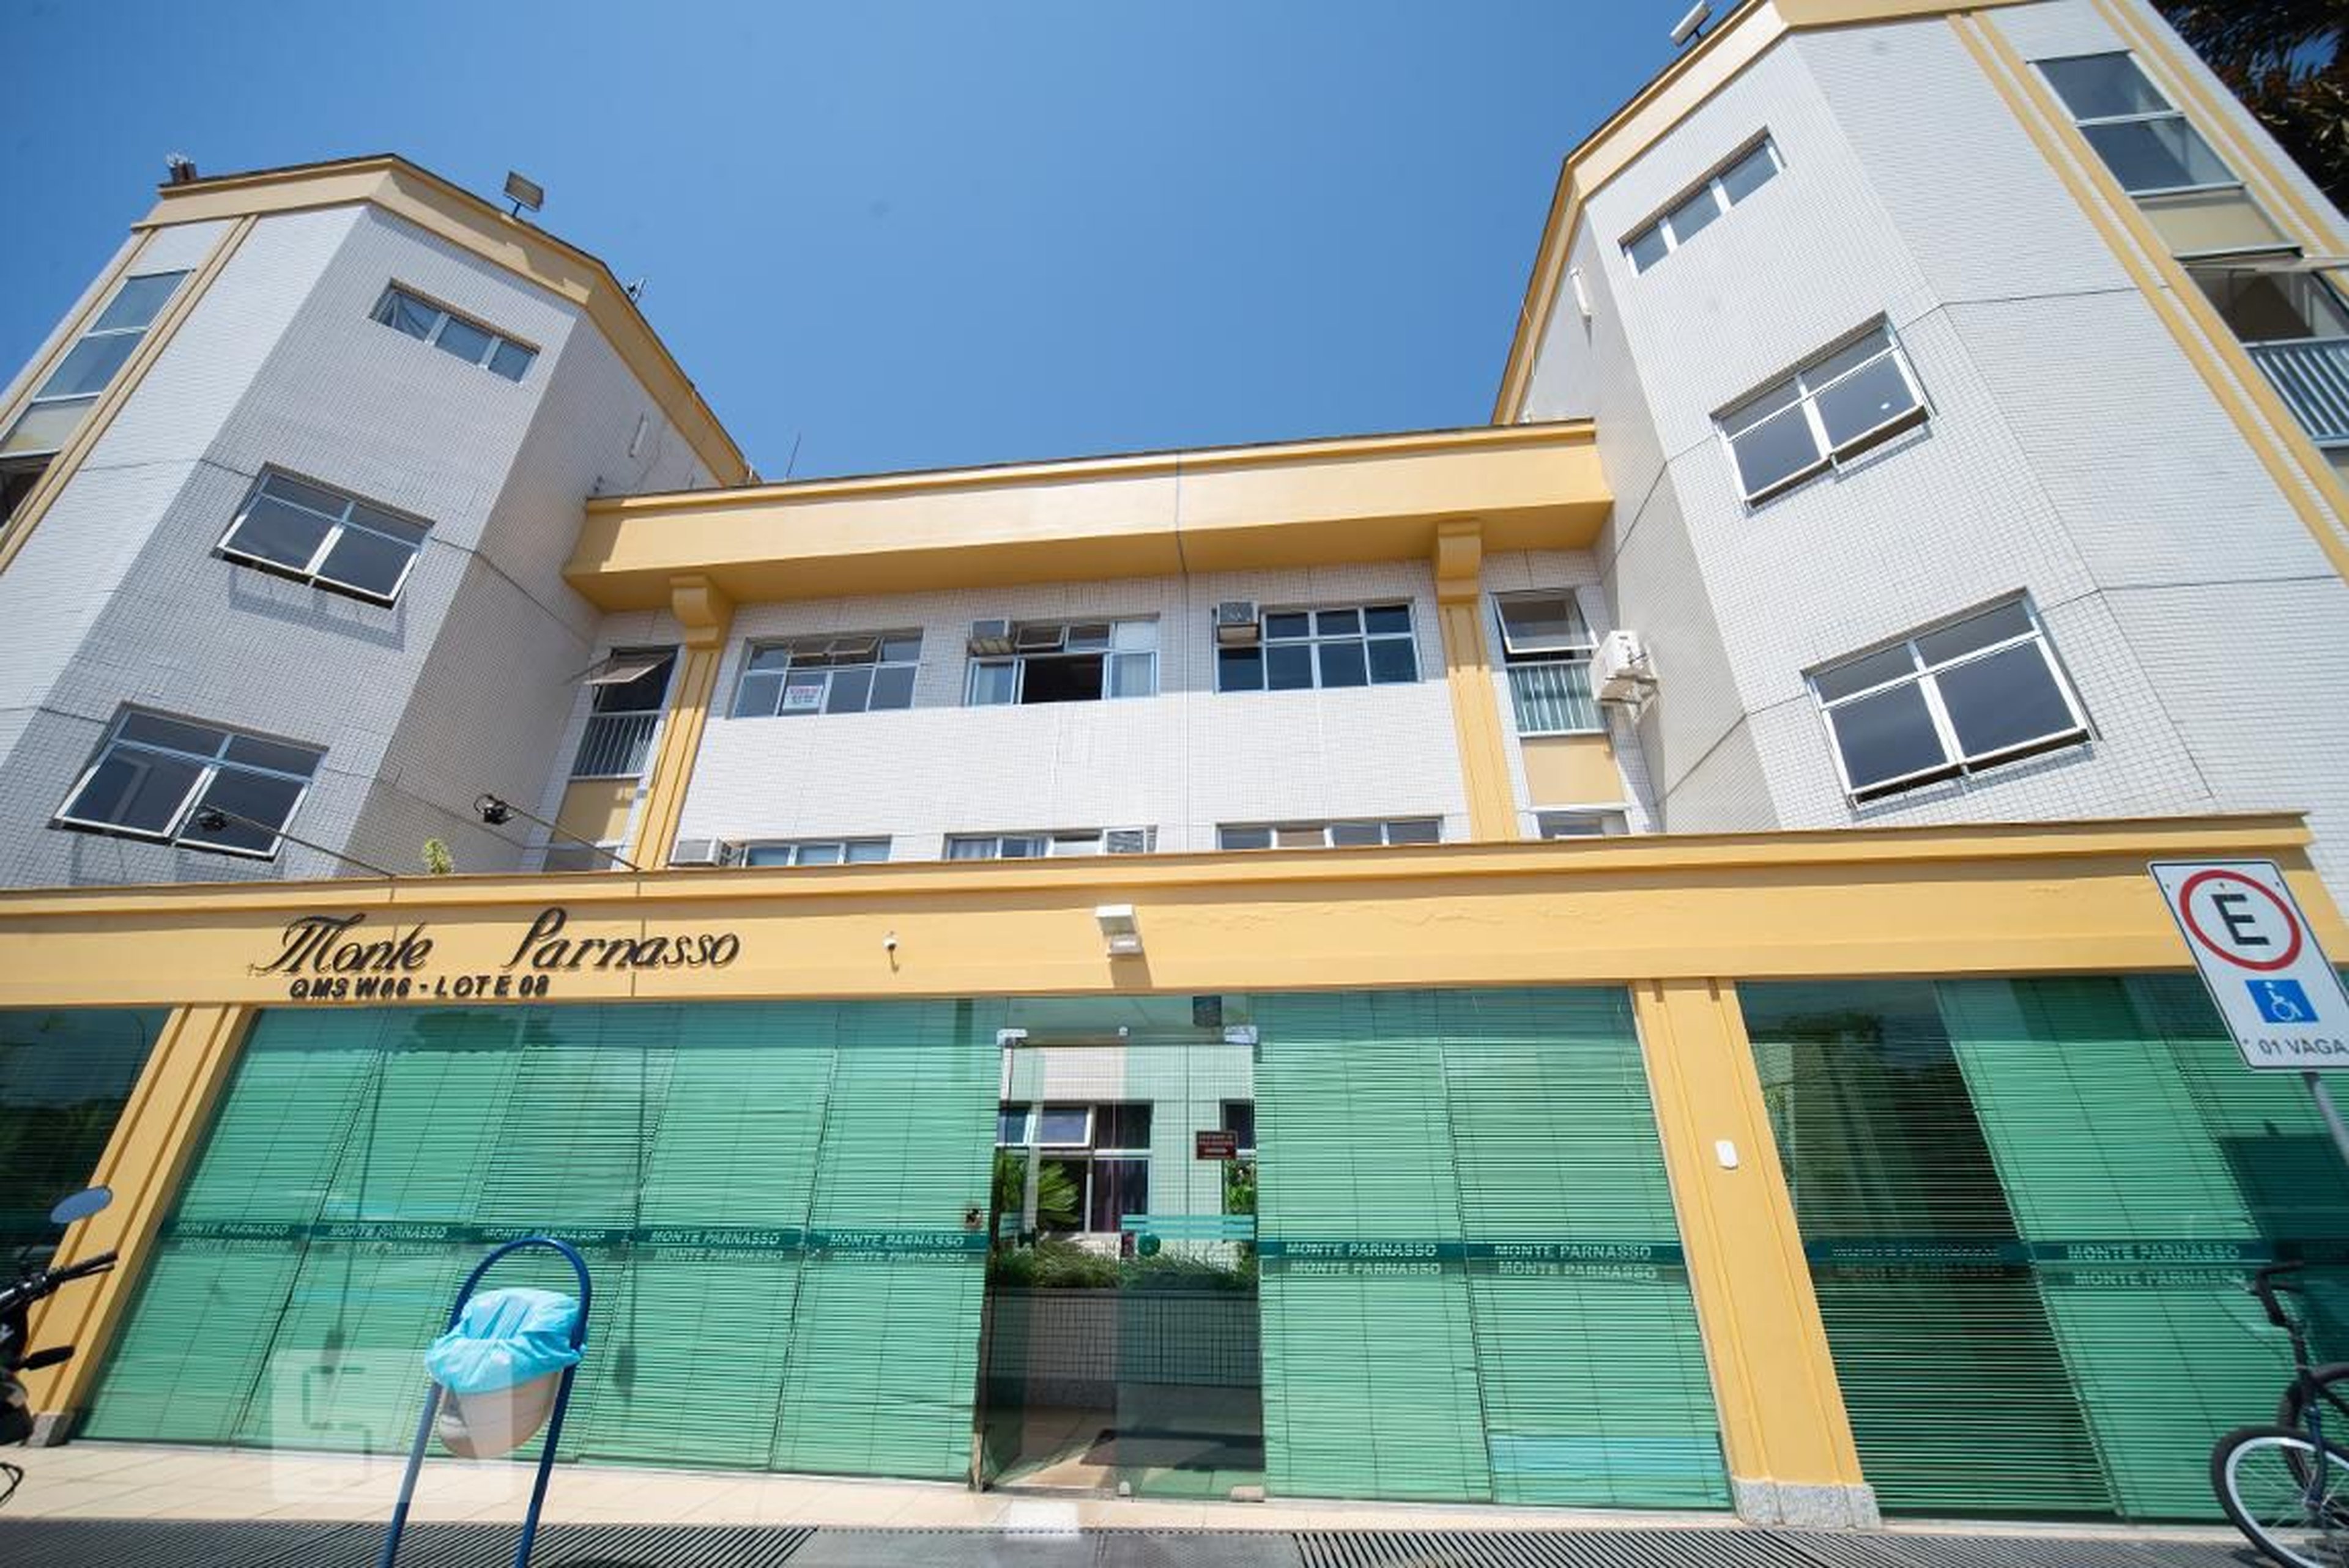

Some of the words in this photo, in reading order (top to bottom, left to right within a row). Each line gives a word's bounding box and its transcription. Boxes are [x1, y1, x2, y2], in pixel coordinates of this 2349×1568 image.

[2210, 893, 2271, 945] E
[252, 912, 432, 973] Monte
[500, 907, 740, 972] Parnasso
[2258, 1038, 2282, 1056] 01
[2285, 1038, 2349, 1055] VAGA
[649, 1230, 701, 1243] MONTE
[703, 1230, 781, 1244] PARNASSO
[828, 1234, 883, 1247] MONTE
[885, 1234, 965, 1249] PARNASSO
[1286, 1243, 1344, 1256] MONTE
[1349, 1243, 1438, 1257] PARNASSO
[1494, 1245, 1557, 1257] MONTE
[1560, 1245, 1652, 1260] PARNASSO
[2068, 1244, 2134, 1260] MONTE
[2140, 1243, 2241, 1260] PARNASSO
[1499, 1261, 1560, 1275] MONTE
[1564, 1263, 1658, 1279] PARNASSO
